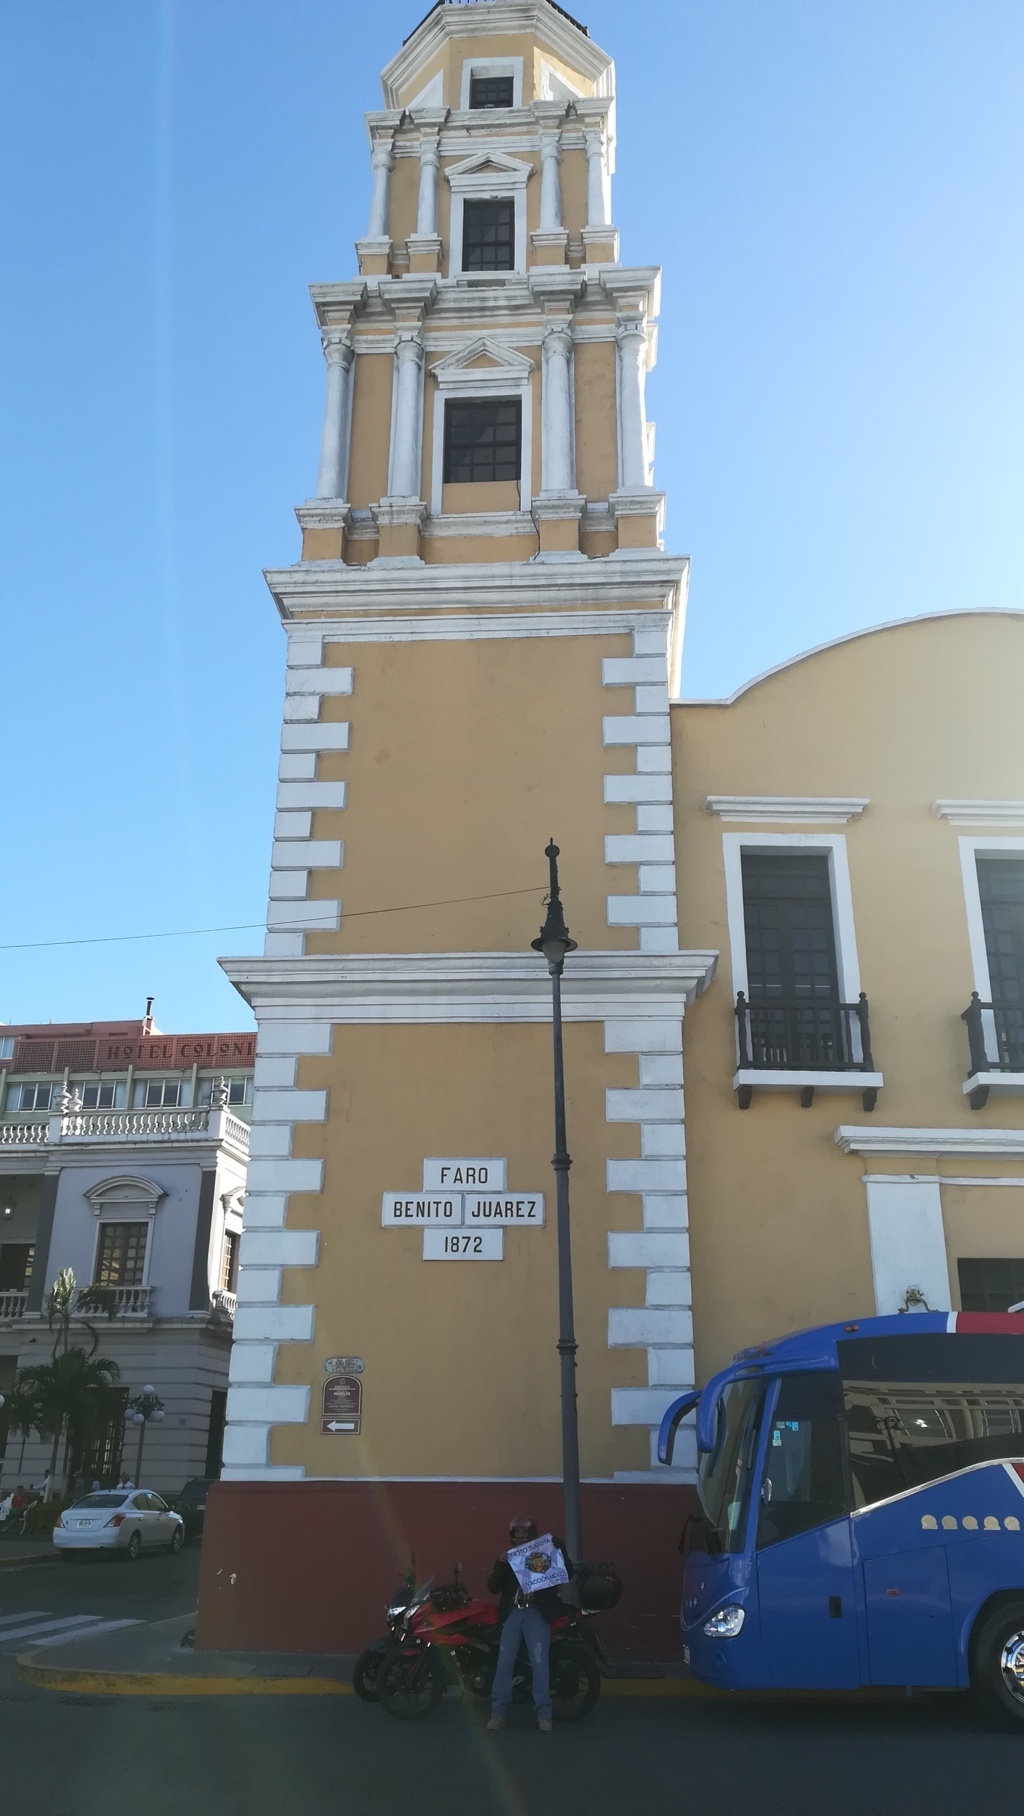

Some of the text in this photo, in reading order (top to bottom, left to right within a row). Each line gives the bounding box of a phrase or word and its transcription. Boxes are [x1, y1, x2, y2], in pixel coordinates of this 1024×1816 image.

[107, 1044, 174, 1060] HOTEL
[440, 1167, 489, 1184] FARO
[393, 1201, 537, 1218] BENITO JUAREZ
[444, 1236, 483, 1253] 1872
[510, 1538, 550, 1557] MOTO TURISTA
